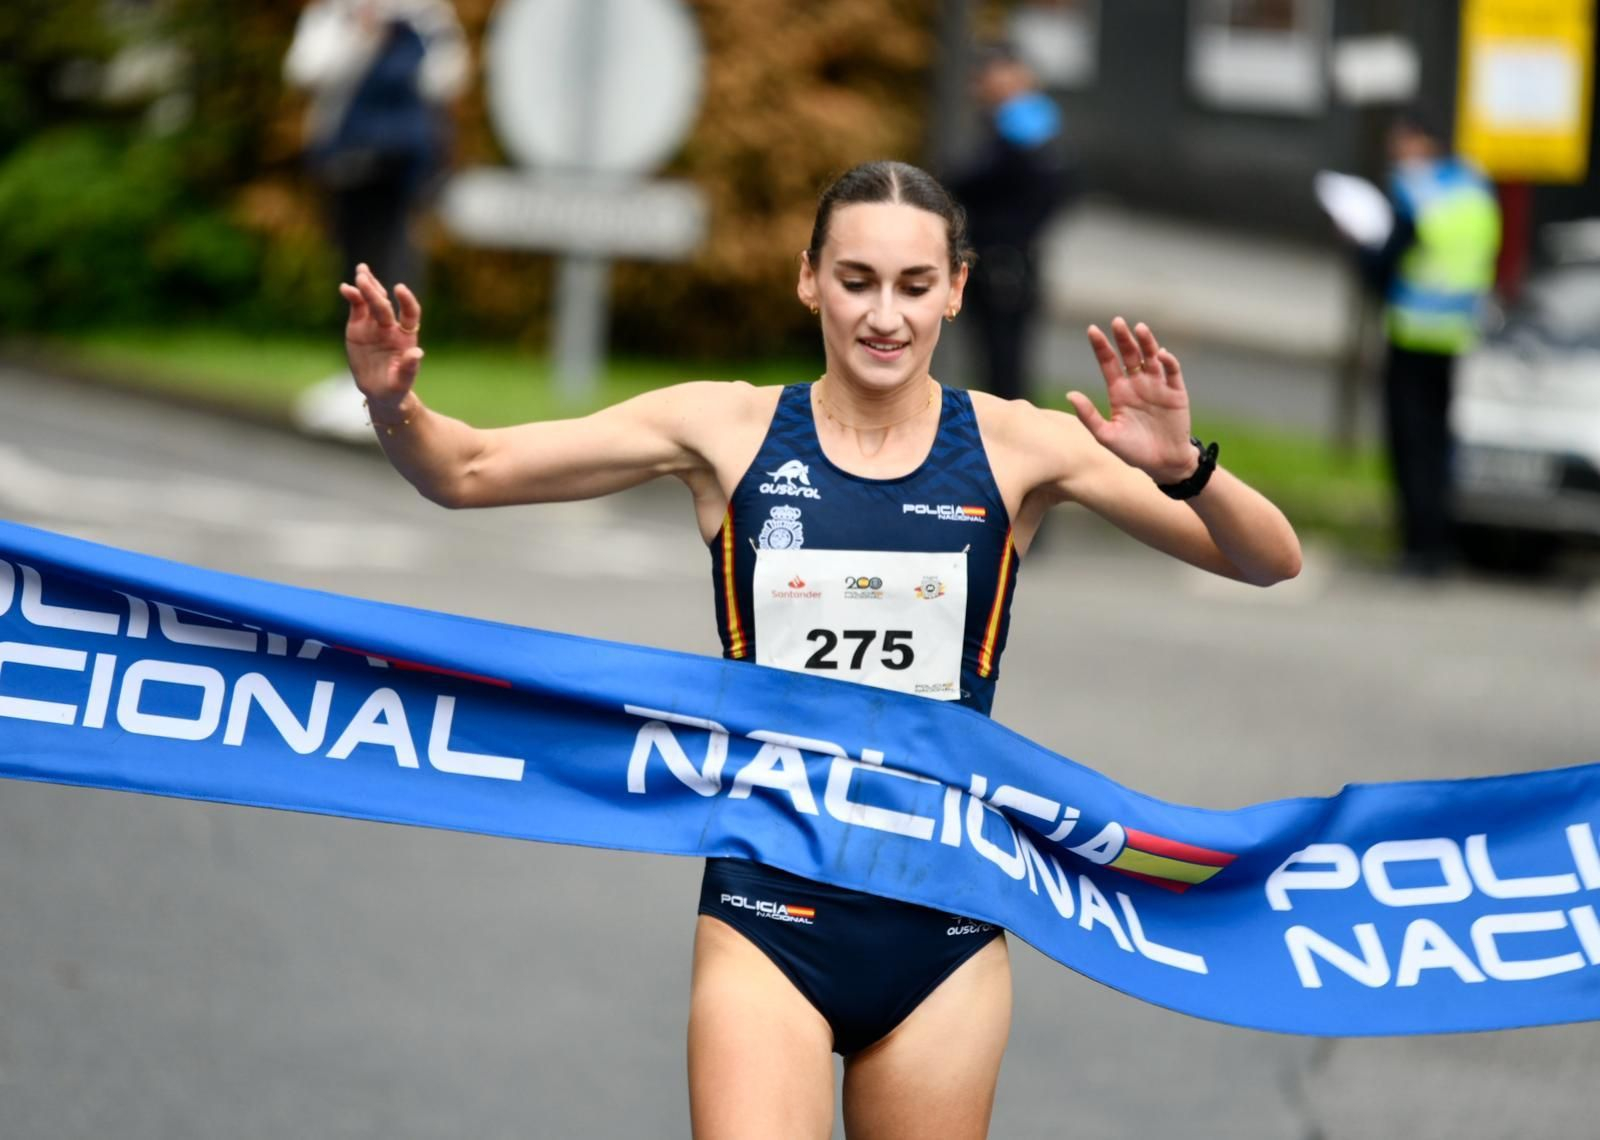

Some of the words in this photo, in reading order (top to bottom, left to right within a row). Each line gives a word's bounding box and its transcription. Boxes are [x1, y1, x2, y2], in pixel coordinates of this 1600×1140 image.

[760, 483, 821, 499] austral
[938, 514, 985, 522] NACIONAL
[772, 590, 822, 599] Santander
[804, 629, 915, 670] 275
[756, 911, 814, 925] NACIONAL
